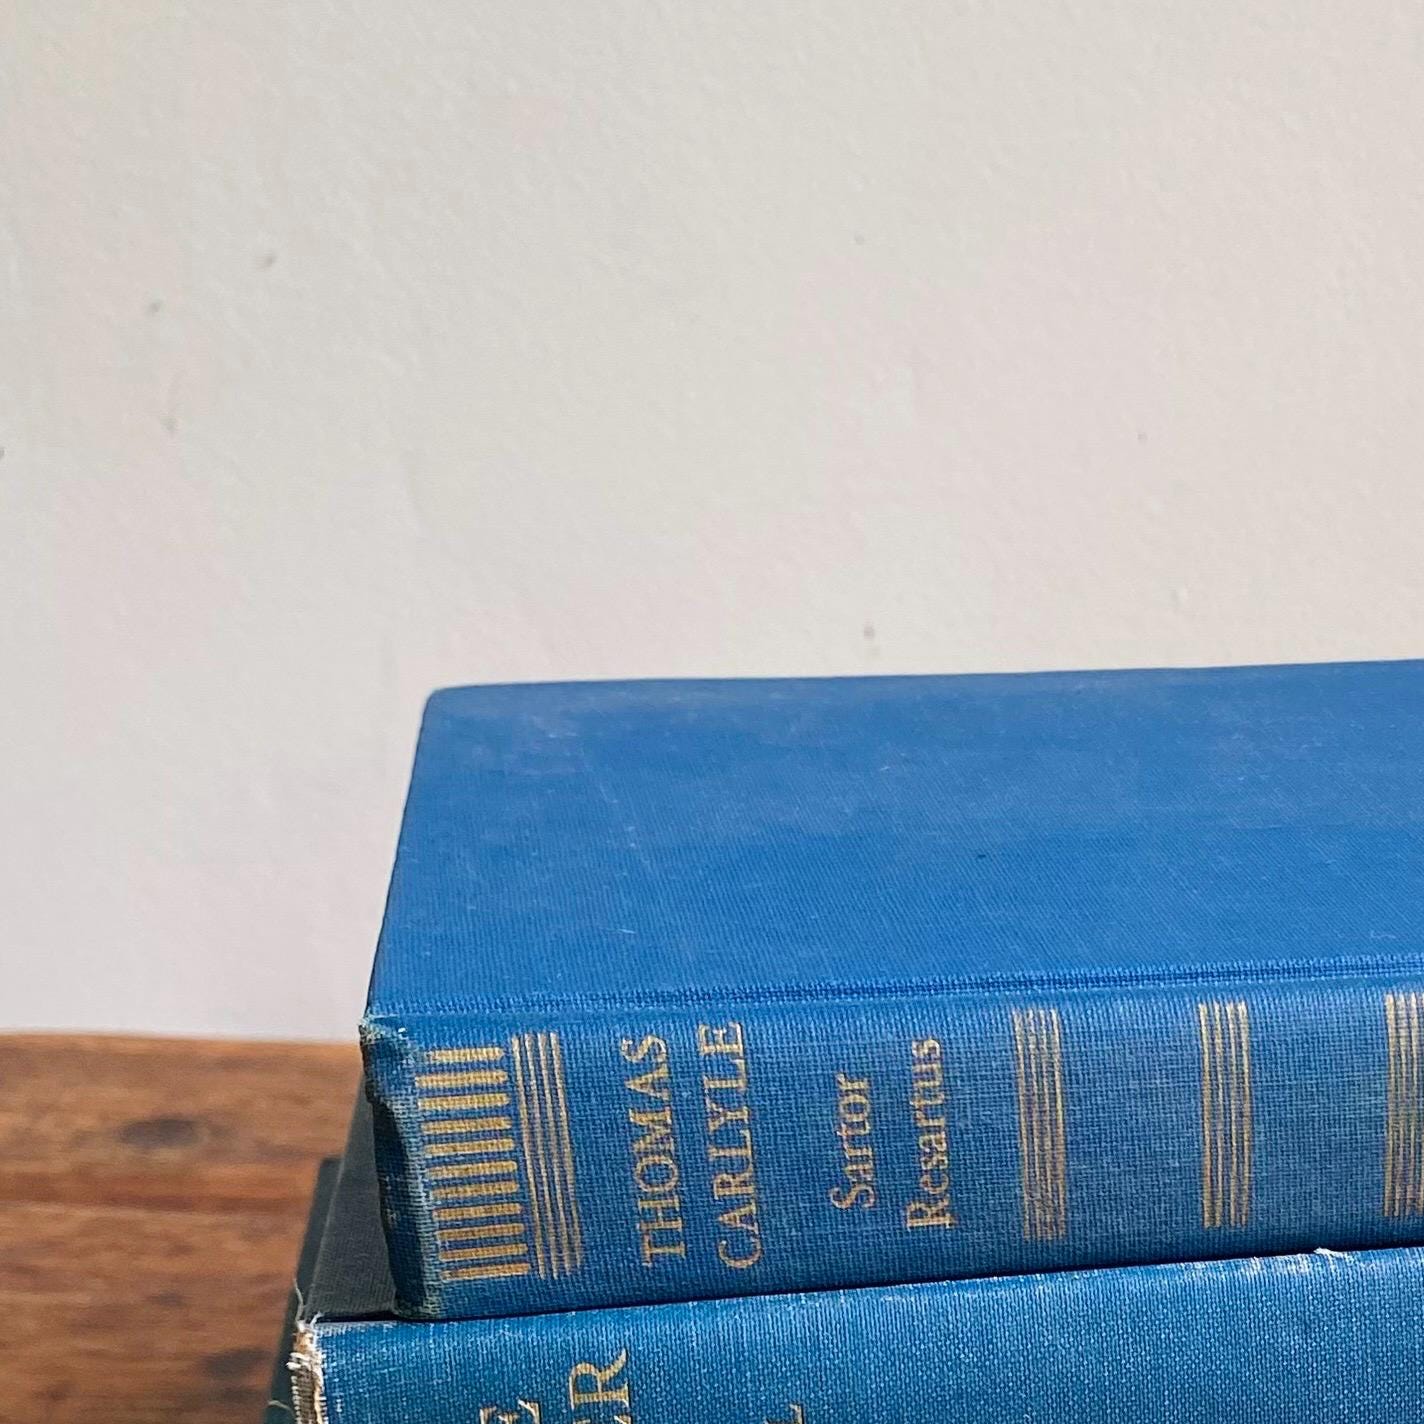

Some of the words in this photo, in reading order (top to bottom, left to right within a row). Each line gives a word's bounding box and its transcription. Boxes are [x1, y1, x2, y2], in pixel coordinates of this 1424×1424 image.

[621, 1033, 687, 1267] THOMAS
[700, 1021, 764, 1269] CARLYLE
[830, 1073, 876, 1211] Sartor
[907, 1037, 955, 1232] Resartus
